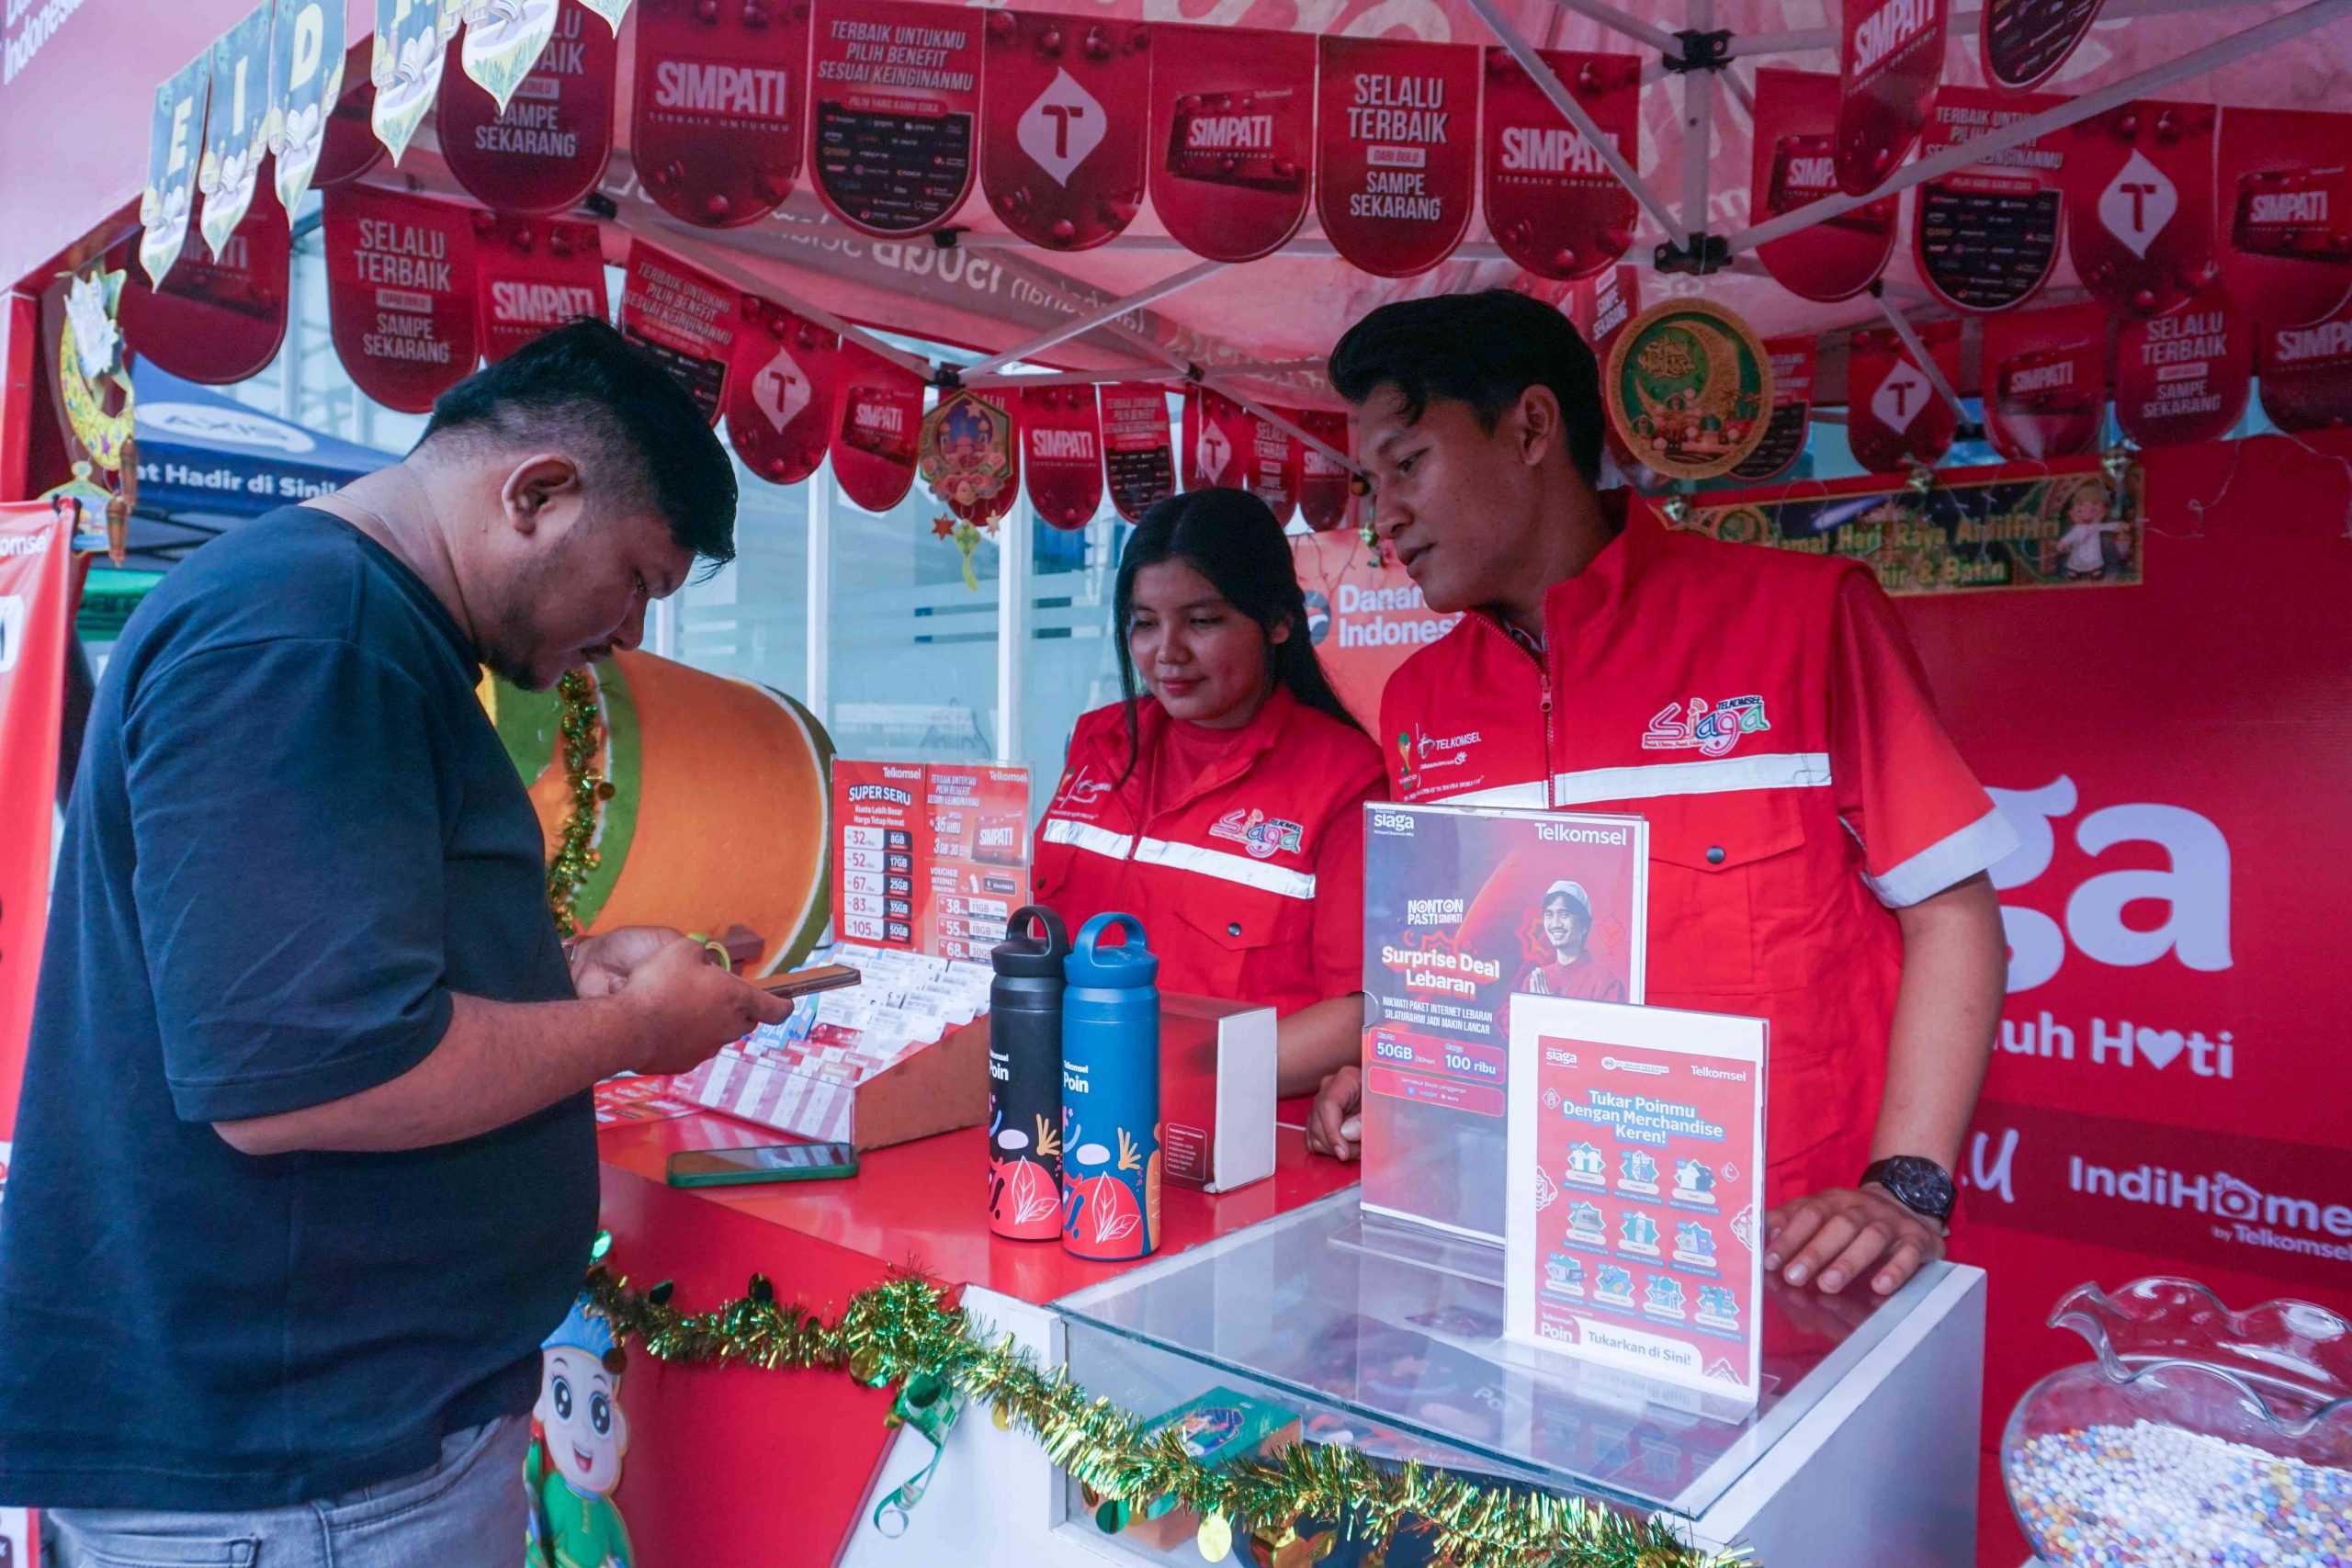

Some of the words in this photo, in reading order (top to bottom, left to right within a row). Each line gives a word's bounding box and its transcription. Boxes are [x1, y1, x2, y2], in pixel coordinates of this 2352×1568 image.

[831, 20, 891, 43] TERBAIK
[895, 26, 966, 50] UNTUKMU
[845, 42, 884, 62] PILIH
[887, 46, 948, 68] BENEFIT
[818, 61, 870, 82] SESUAI
[874, 65, 974, 92] KEINGINANMU
[655, 61, 786, 116] SIMPATI
[1354, 73, 1443, 109] SELALU
[493, 104, 559, 130] SAMPE
[649, 112, 711, 126] TERBAIK
[1347, 107, 1448, 143] TERBAIK
[475, 125, 576, 158] SEKARANG
[1189, 115, 1272, 148] SIMPATI
[1366, 171, 1426, 195] SAMPE
[1788, 157, 1838, 187] SIMP
[1350, 194, 1441, 220] SEKARANG
[2251, 191, 2327, 222] SIMPATI
[359, 219, 446, 260] SELALU
[353, 249, 452, 292] TERBAIK
[639, 262, 681, 291] TERBAIK
[492, 281, 595, 323] SIMPATI
[646, 281, 674, 305] PILIH
[674, 294, 718, 321] BENEFIT
[378, 312, 434, 340] SAMPE
[2146, 310, 2223, 341] SELALU
[363, 333, 450, 364] SEKARANG
[2142, 334, 2227, 366] TERBAIK
[2276, 321, 2352, 361] SIMP
[2010, 361, 2074, 393] SIMPATI
[2158, 379, 2207, 400] SAMPE
[855, 403, 902, 432] SIMPATI
[1032, 429, 1094, 457] SIMPATI
[164, 462, 243, 491] Hadir
[247, 473, 274, 494] di
[0, 526, 50, 556] omsel
[1339, 610, 1464, 648] Indones
[1718, 696, 1762, 710] TELKOMSEL
[1436, 732, 1482, 750] TELKOMSEL
[883, 767, 922, 779] Telkomsel
[989, 771, 1027, 782] Telkomsel
[849, 785, 882, 802] SUPER
[883, 786, 911, 806] SERU
[854, 805, 871, 815] Kuota
[854, 816, 871, 826] Harga
[1374, 813, 1414, 831] siaga
[853, 830, 865, 845] 32
[889, 834, 905, 844] 8GB
[979, 827, 1013, 846] SIMPATI
[1534, 823, 1627, 846] Telkomsel
[853, 852, 865, 867] 52
[889, 858, 908, 868] 17GB
[854, 875, 866, 890] 67
[931, 867, 957, 877] VOUCHER
[889, 881, 908, 891] 25GB
[854, 897, 866, 911] 83
[889, 903, 908, 913] 35GB
[946, 898, 961, 914] 38
[1408, 899, 1464, 914] NONTON
[853, 920, 872, 936] 105
[946, 920, 960, 936] 55
[1408, 913, 1438, 925] PASTI
[1438, 914, 1463, 924] SIMPATI
[889, 926, 908, 937] 50GB
[947, 942, 961, 957] 68
[1382, 945, 1457, 969] Surprise
[1460, 953, 1500, 978] Deal
[1406, 969, 1476, 995] Lebaran
[1383, 996, 1408, 1009] NIKMATI
[1409, 999, 1429, 1012] PAKET
[1430, 1003, 1462, 1017] INTERNET
[1462, 1009, 1493, 1022] LEBARAN
[1385, 1009, 1426, 1024] SILATURAHMI
[1426, 1015, 1441, 1026] JADI
[1442, 1018, 1464, 1031] MAKIN
[1464, 1021, 1490, 1035] LANCAR
[989, 1049, 1009, 1062] komsel
[1377, 1042, 1412, 1060] 50GB
[989, 1059, 1009, 1081] Poin
[1444, 1054, 1471, 1070] 100
[1474, 1060, 1496, 1075] ribu
[1690, 1066, 1747, 1082] Telkomsel
[1064, 1071, 1089, 1093] Poin
[1589, 1089, 1629, 1109] Tukar
[1635, 1097, 1695, 1118] Poinmu
[1564, 1101, 1620, 1122] Dengan
[1623, 1110, 1723, 1137] Merchandise
[1616, 1123, 1666, 1144] Keren!
[2212, 1225, 2232, 1242] by
[2233, 1223, 2352, 1262] Telkomsel
[1542, 1312, 1573, 1325] Telkomsel
[1541, 1321, 1573, 1342] Poin
[1588, 1330, 1645, 1355] Tukarkan
[1649, 1347, 1660, 1358] di
[1663, 1349, 1690, 1366] Sini!
